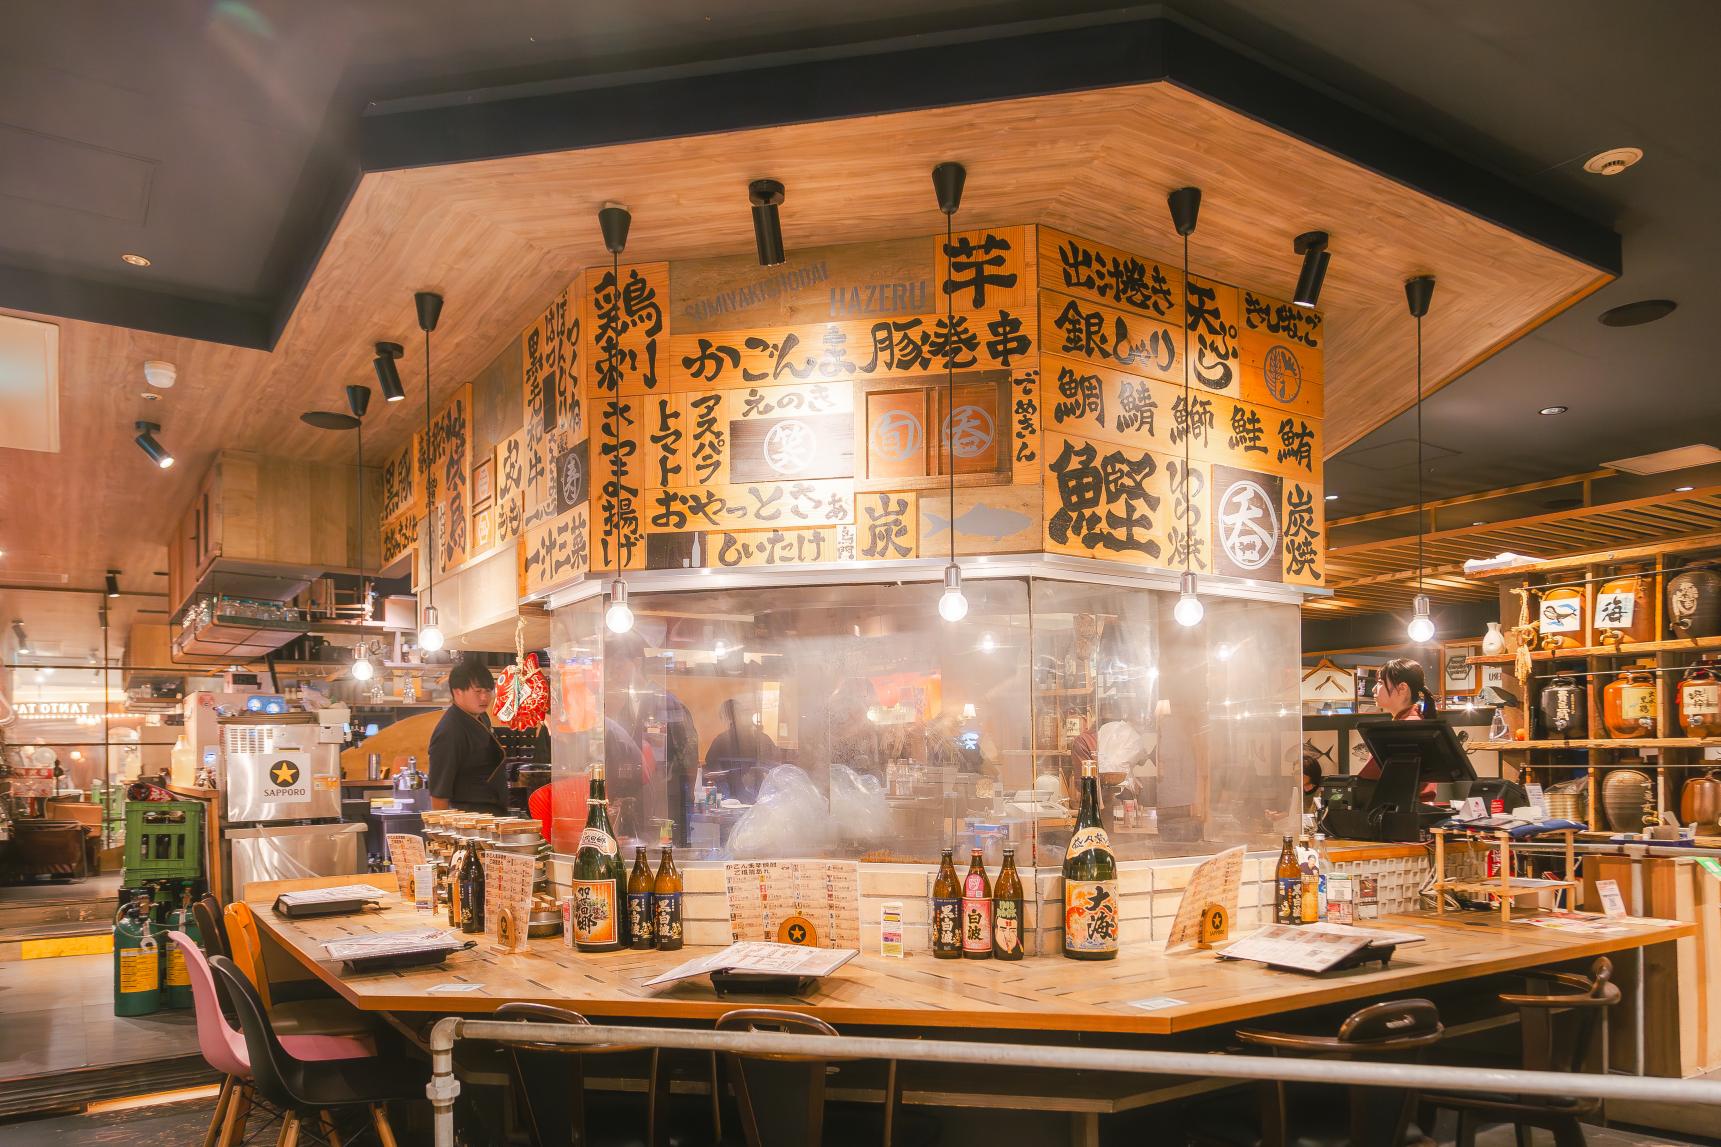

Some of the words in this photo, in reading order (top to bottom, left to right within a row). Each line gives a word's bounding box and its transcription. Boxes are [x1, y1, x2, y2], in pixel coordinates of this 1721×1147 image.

[830, 280, 927, 318] HAZERU
[943, 234, 1018, 309] 芋
[1186, 280, 1239, 390] 天ぷら
[566, 317, 582, 434] つくね
[1055, 366, 1105, 428] 鯛
[1117, 380, 1158, 437] 鯖
[650, 399, 683, 488] トマト
[690, 393, 725, 485] アスパラ
[601, 401, 645, 568] さつま揚げ
[718, 529, 826, 567] しいたけ
[862, 493, 913, 558] 炭
[1284, 483, 1322, 581] 炭焼
[263, 788, 306, 797] SAPPORO
[968, 908, 984, 941] 白波
[1085, 885, 1116, 941] 大海
